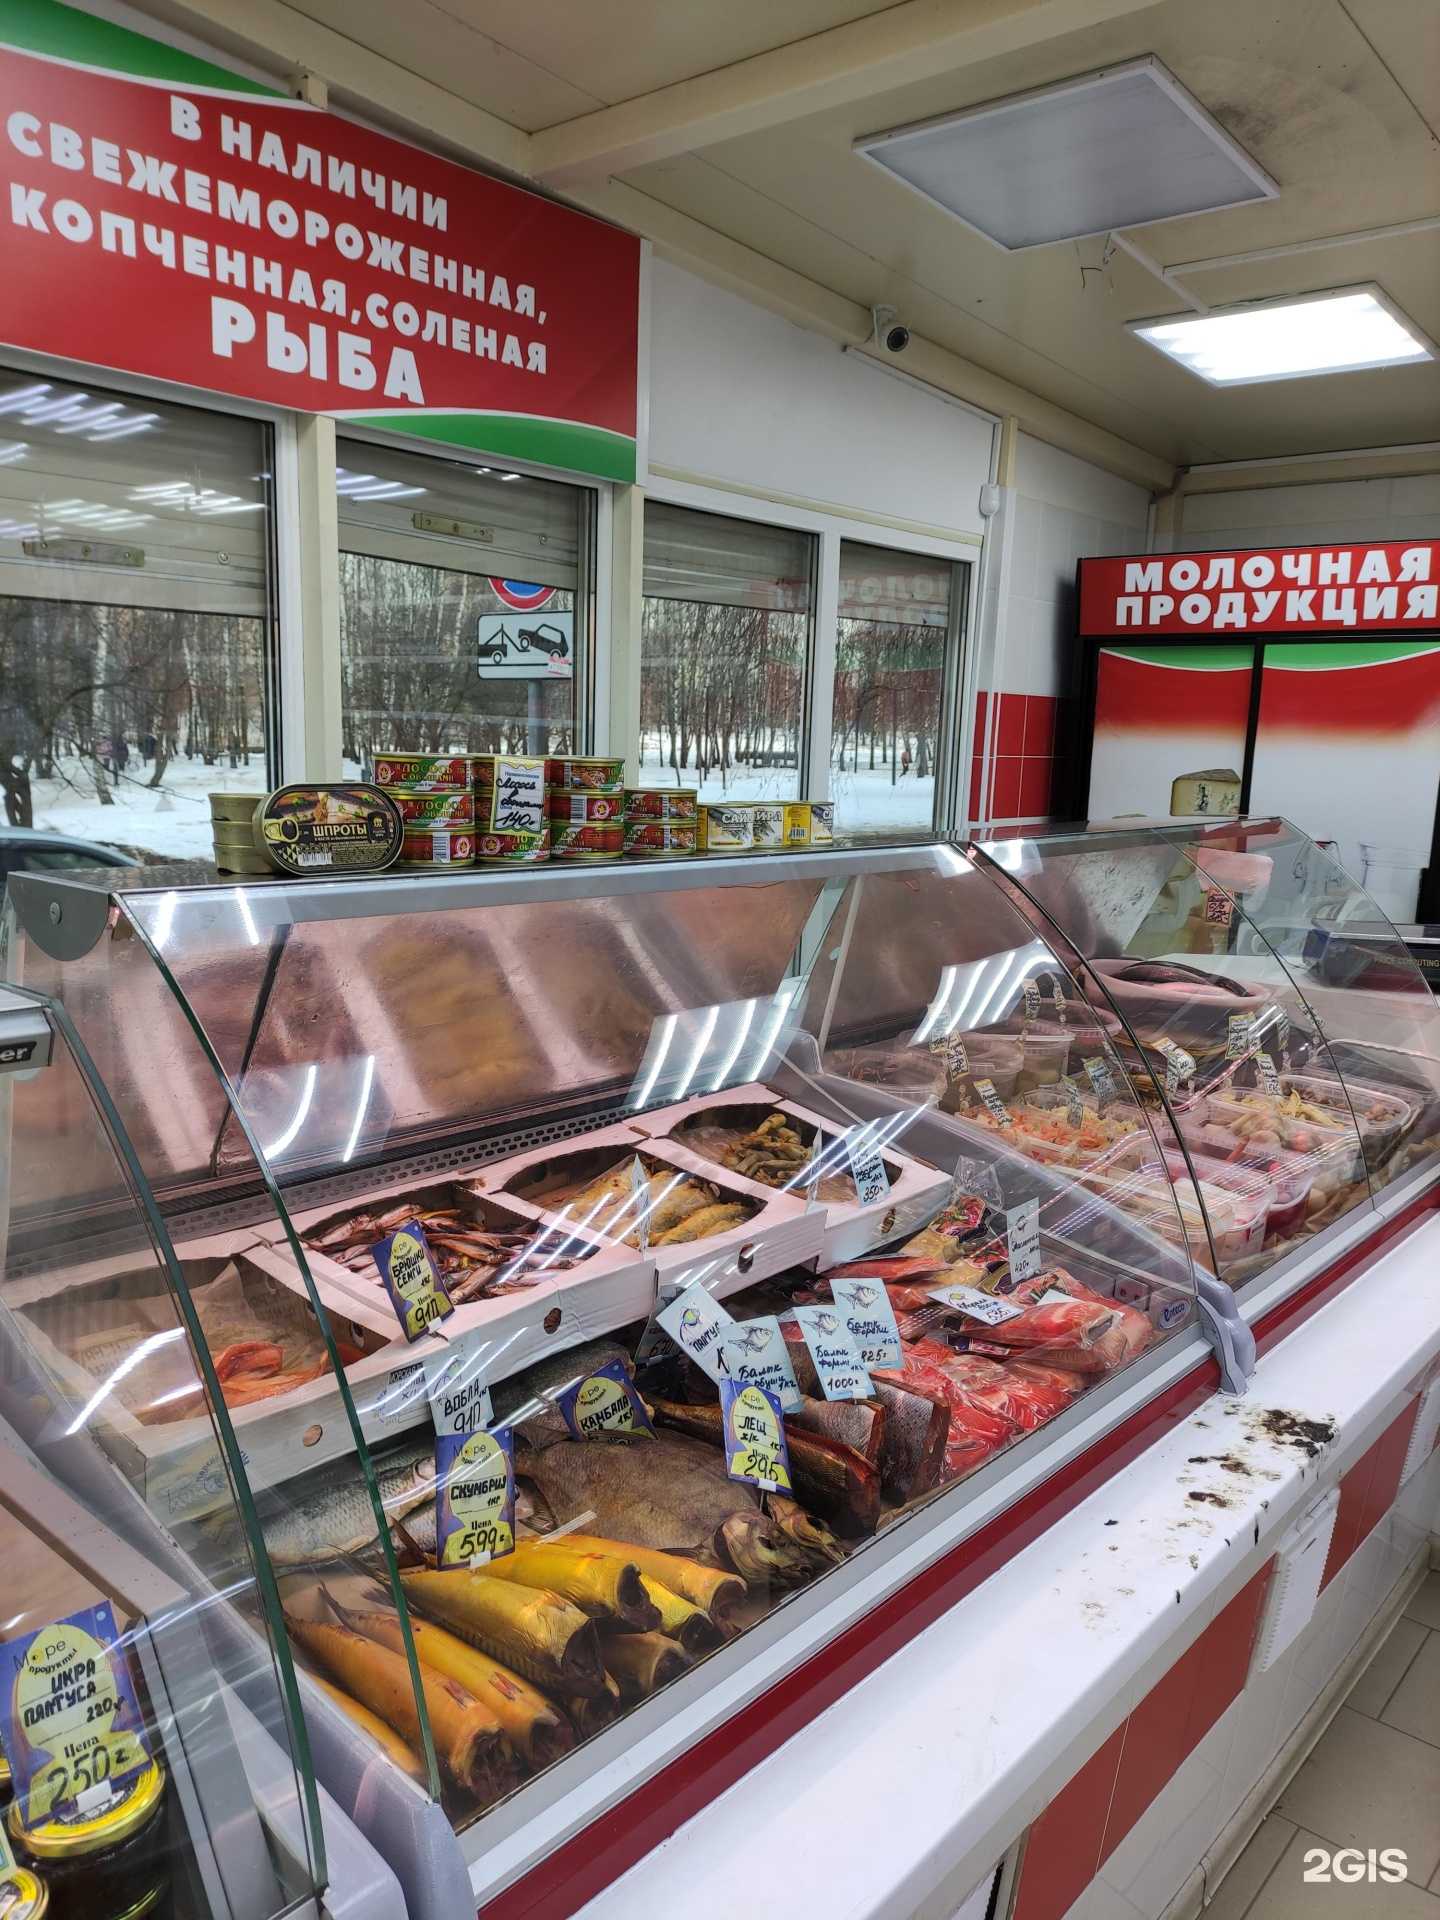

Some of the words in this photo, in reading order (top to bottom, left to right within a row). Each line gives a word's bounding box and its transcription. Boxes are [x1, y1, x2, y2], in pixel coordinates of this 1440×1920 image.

[170, 95, 202, 141] В
[221, 114, 448, 232] НАЛИЧИИ
[7, 111, 549, 325] СВЕЖЕМОРОЖЕННАЯ,
[211, 295, 425, 405] РЫБА
[1124, 547, 1432, 593] МОЛОЧНАЯ
[1115, 584, 1439, 629] ПРОДУКЦИЯ
[312, 823, 368, 838] ШПРОТЫ
[580, 1394, 630, 1432] КАМБАЛА
[738, 1415, 767, 1436] ЛЕЩ
[51, 1657, 97, 1694] ИКРА
[63, 1735, 100, 1759] Цена
